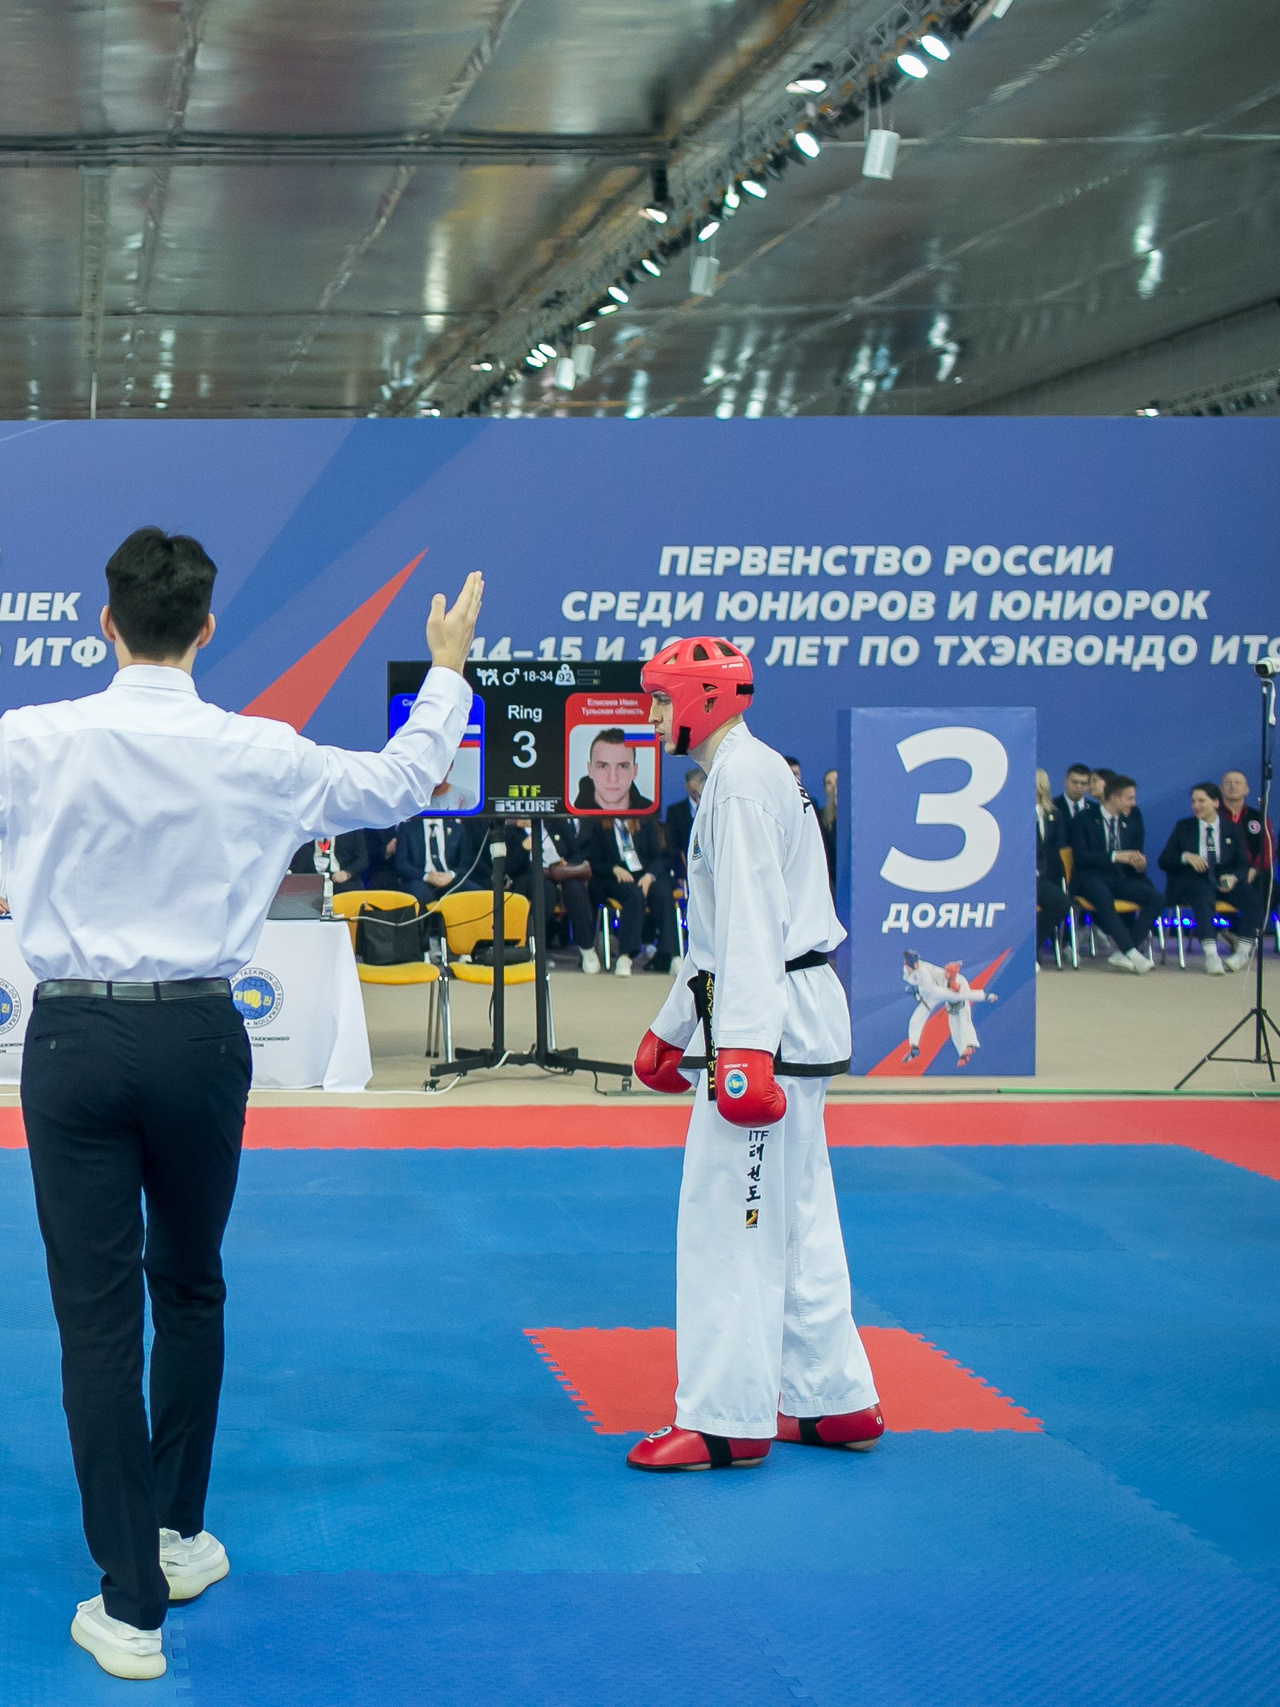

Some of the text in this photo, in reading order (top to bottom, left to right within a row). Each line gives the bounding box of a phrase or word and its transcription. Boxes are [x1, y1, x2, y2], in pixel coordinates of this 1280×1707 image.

[659, 545, 1115, 576] ПЕРВЕНСТВО РОССИИ
[562, 590, 1210, 627] СРЕДИ ЮНИОРОВ И ЮНИОРОК
[13, 635, 108, 669] ИТФ
[595, 636, 626, 661] И
[764, 635, 850, 667] ЛЕТ
[859, 635, 920, 666] ПО
[934, 635, 1198, 672] ТХЭКВОНДО
[523, 670, 554, 682] 18-34
[558, 672, 573, 683] 92
[508, 704, 543, 722] Ring
[511, 730, 538, 769] 3
[880, 726, 1009, 893] 3
[881, 902, 1006, 933] ДОЯНГ
[748, 1129, 770, 1142] ITF
